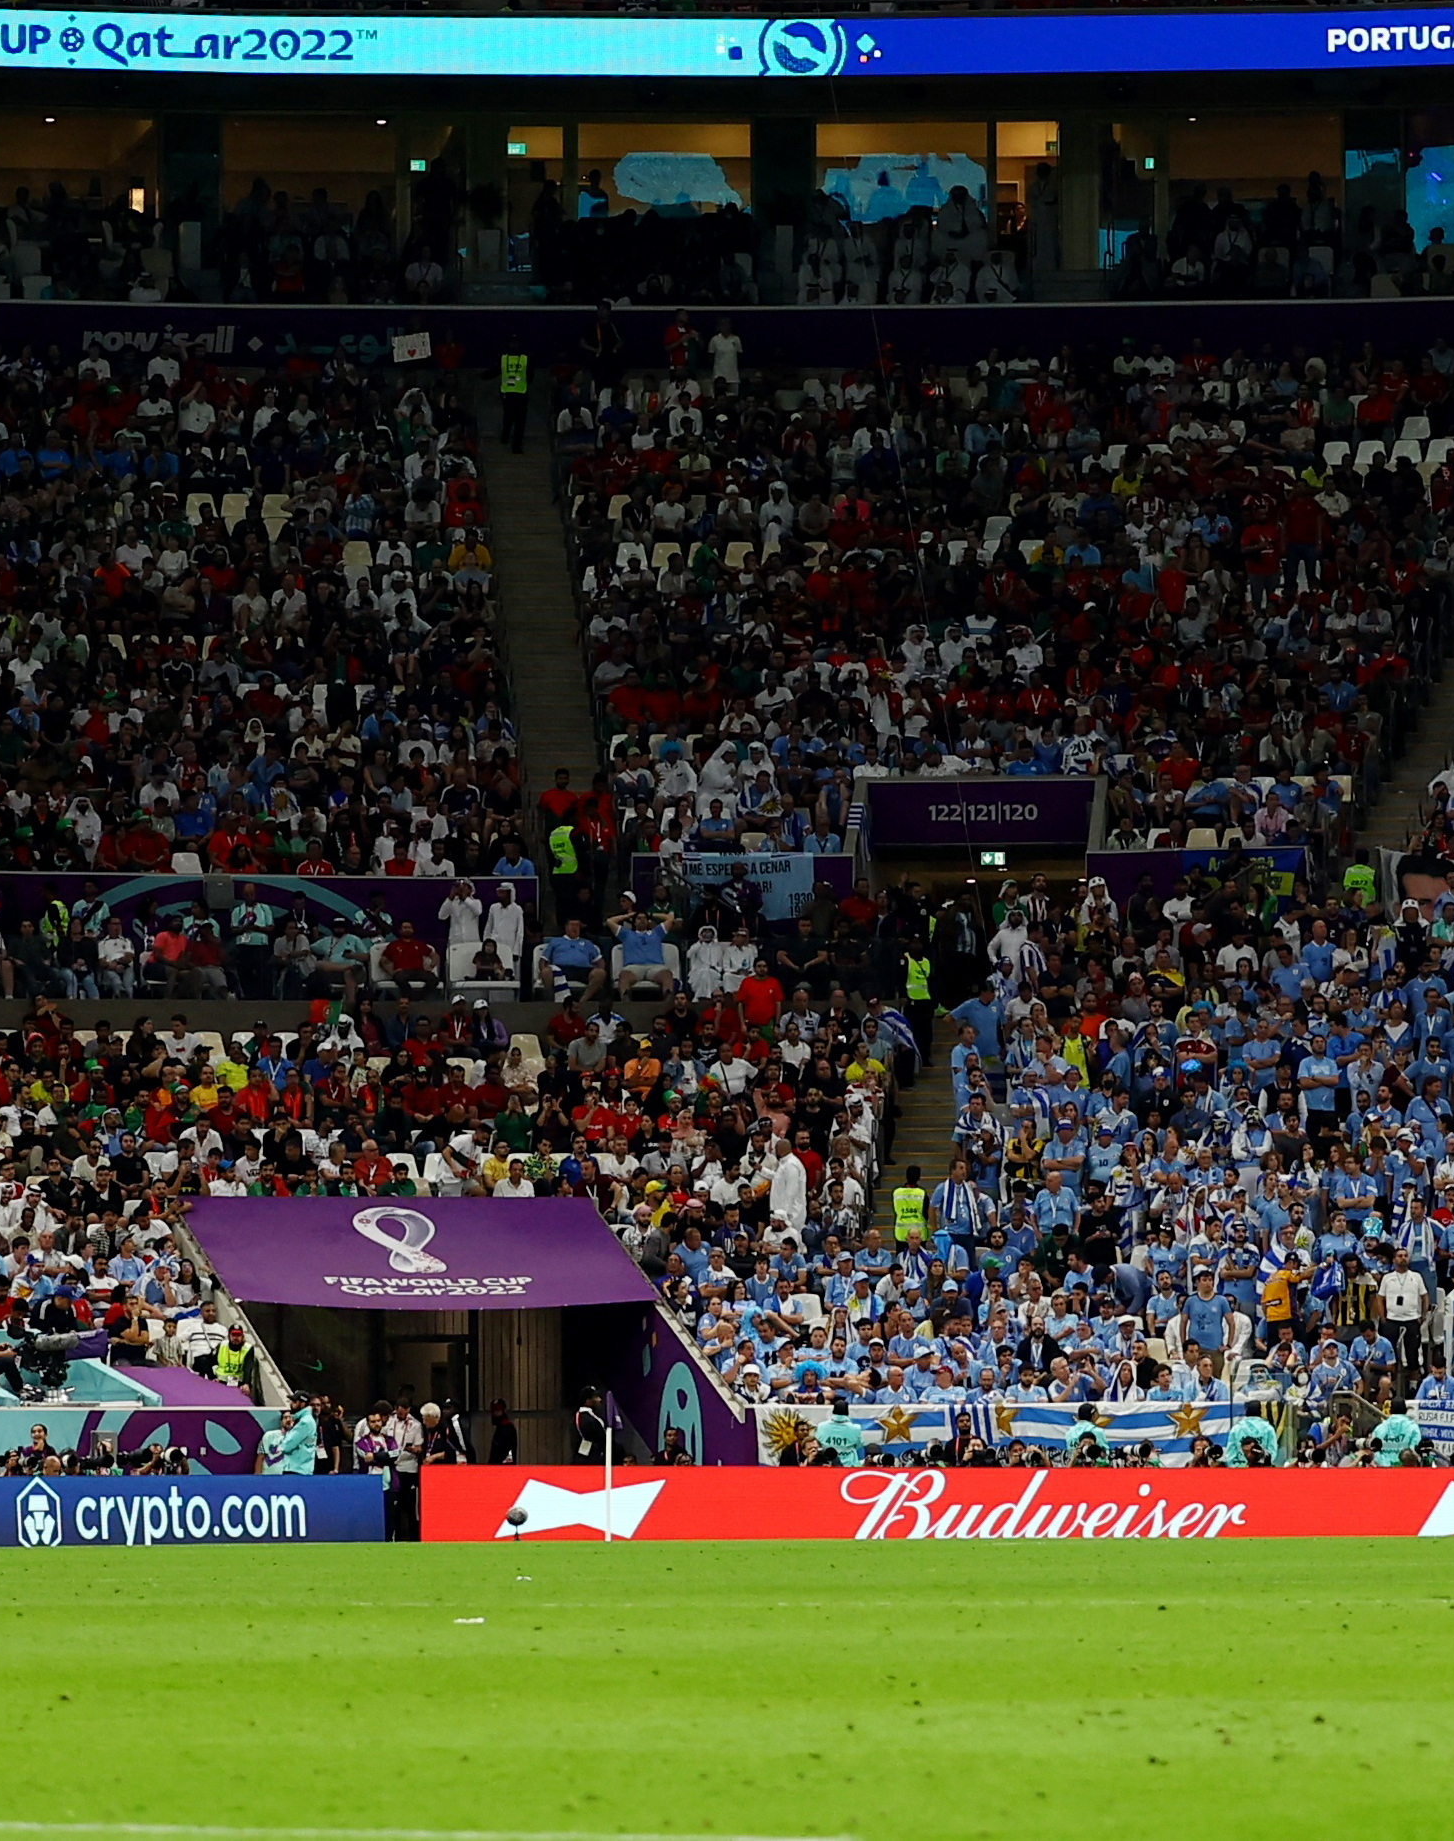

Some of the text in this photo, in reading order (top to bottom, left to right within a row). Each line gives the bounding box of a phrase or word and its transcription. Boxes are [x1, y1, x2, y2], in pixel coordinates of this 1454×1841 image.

[323, 1276, 533, 1287] FIFA WORLD CUP
[75, 1485, 306, 1547] crypto.com
[840, 1468, 1246, 1540] Budweiser
